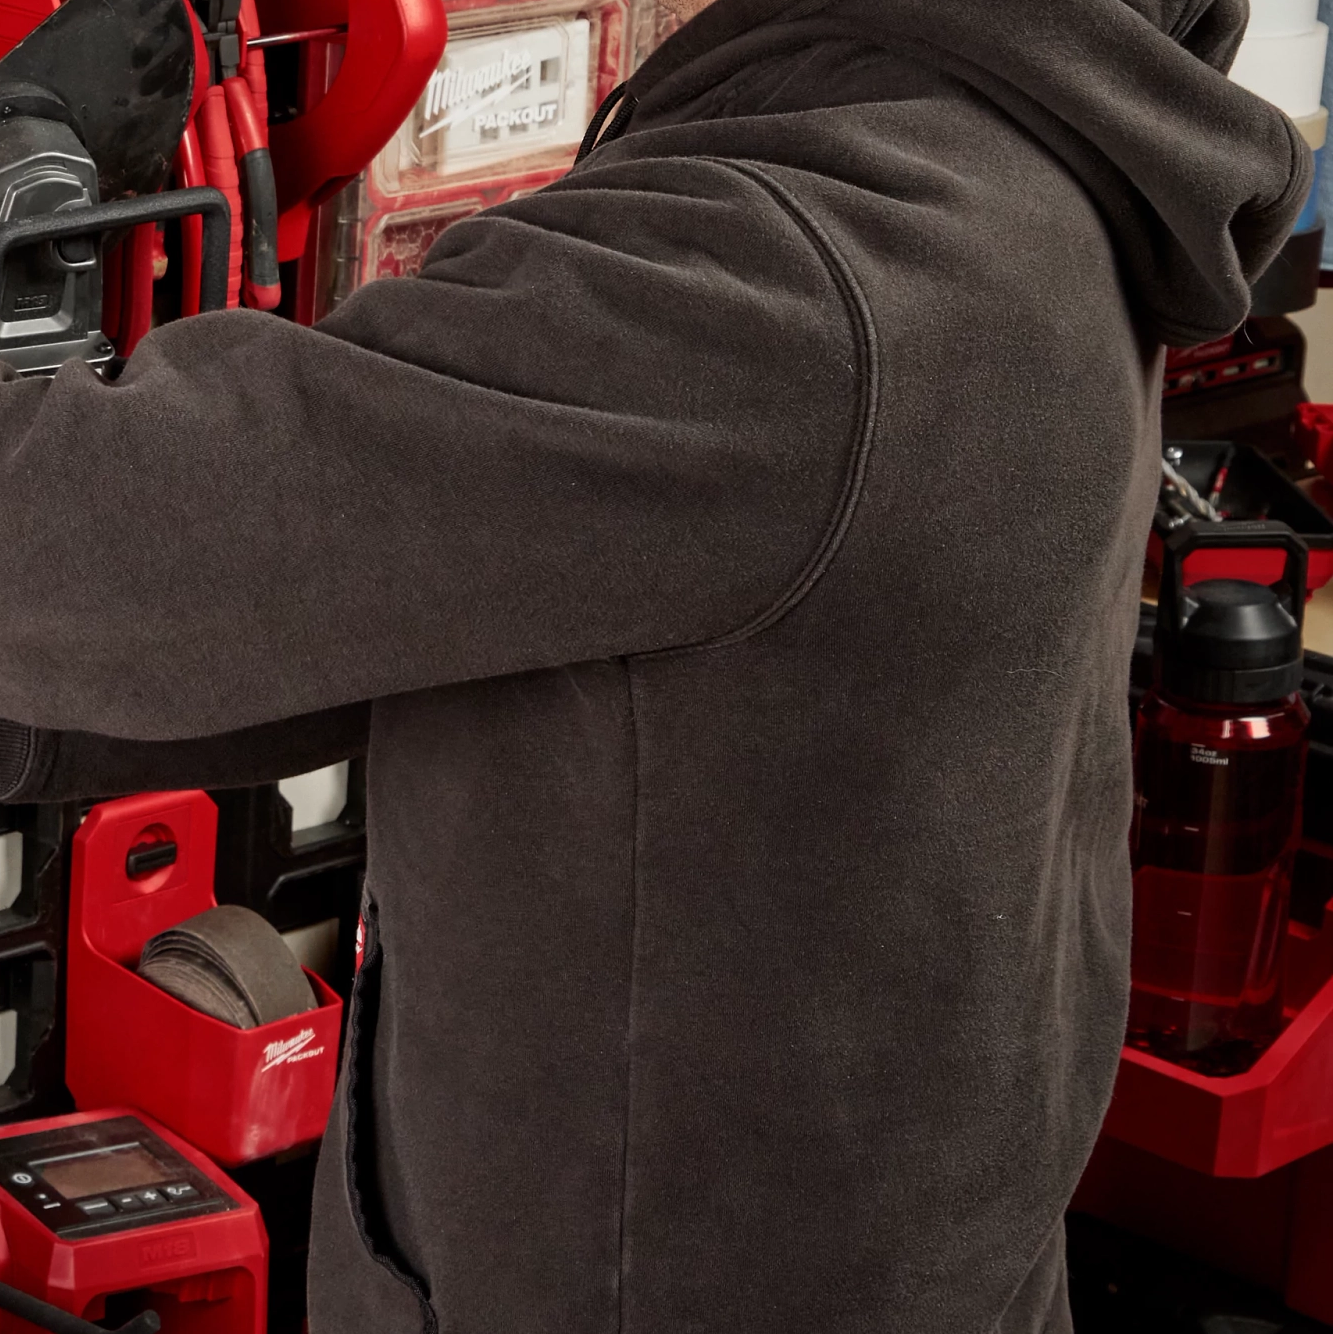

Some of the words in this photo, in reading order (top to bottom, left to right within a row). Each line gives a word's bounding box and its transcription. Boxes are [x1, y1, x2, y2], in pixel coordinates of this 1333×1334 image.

[474, 103, 557, 130] PACKOUT
[264, 1028, 315, 1063] Milwaukee
[287, 1045, 325, 1063] PACKOUT
